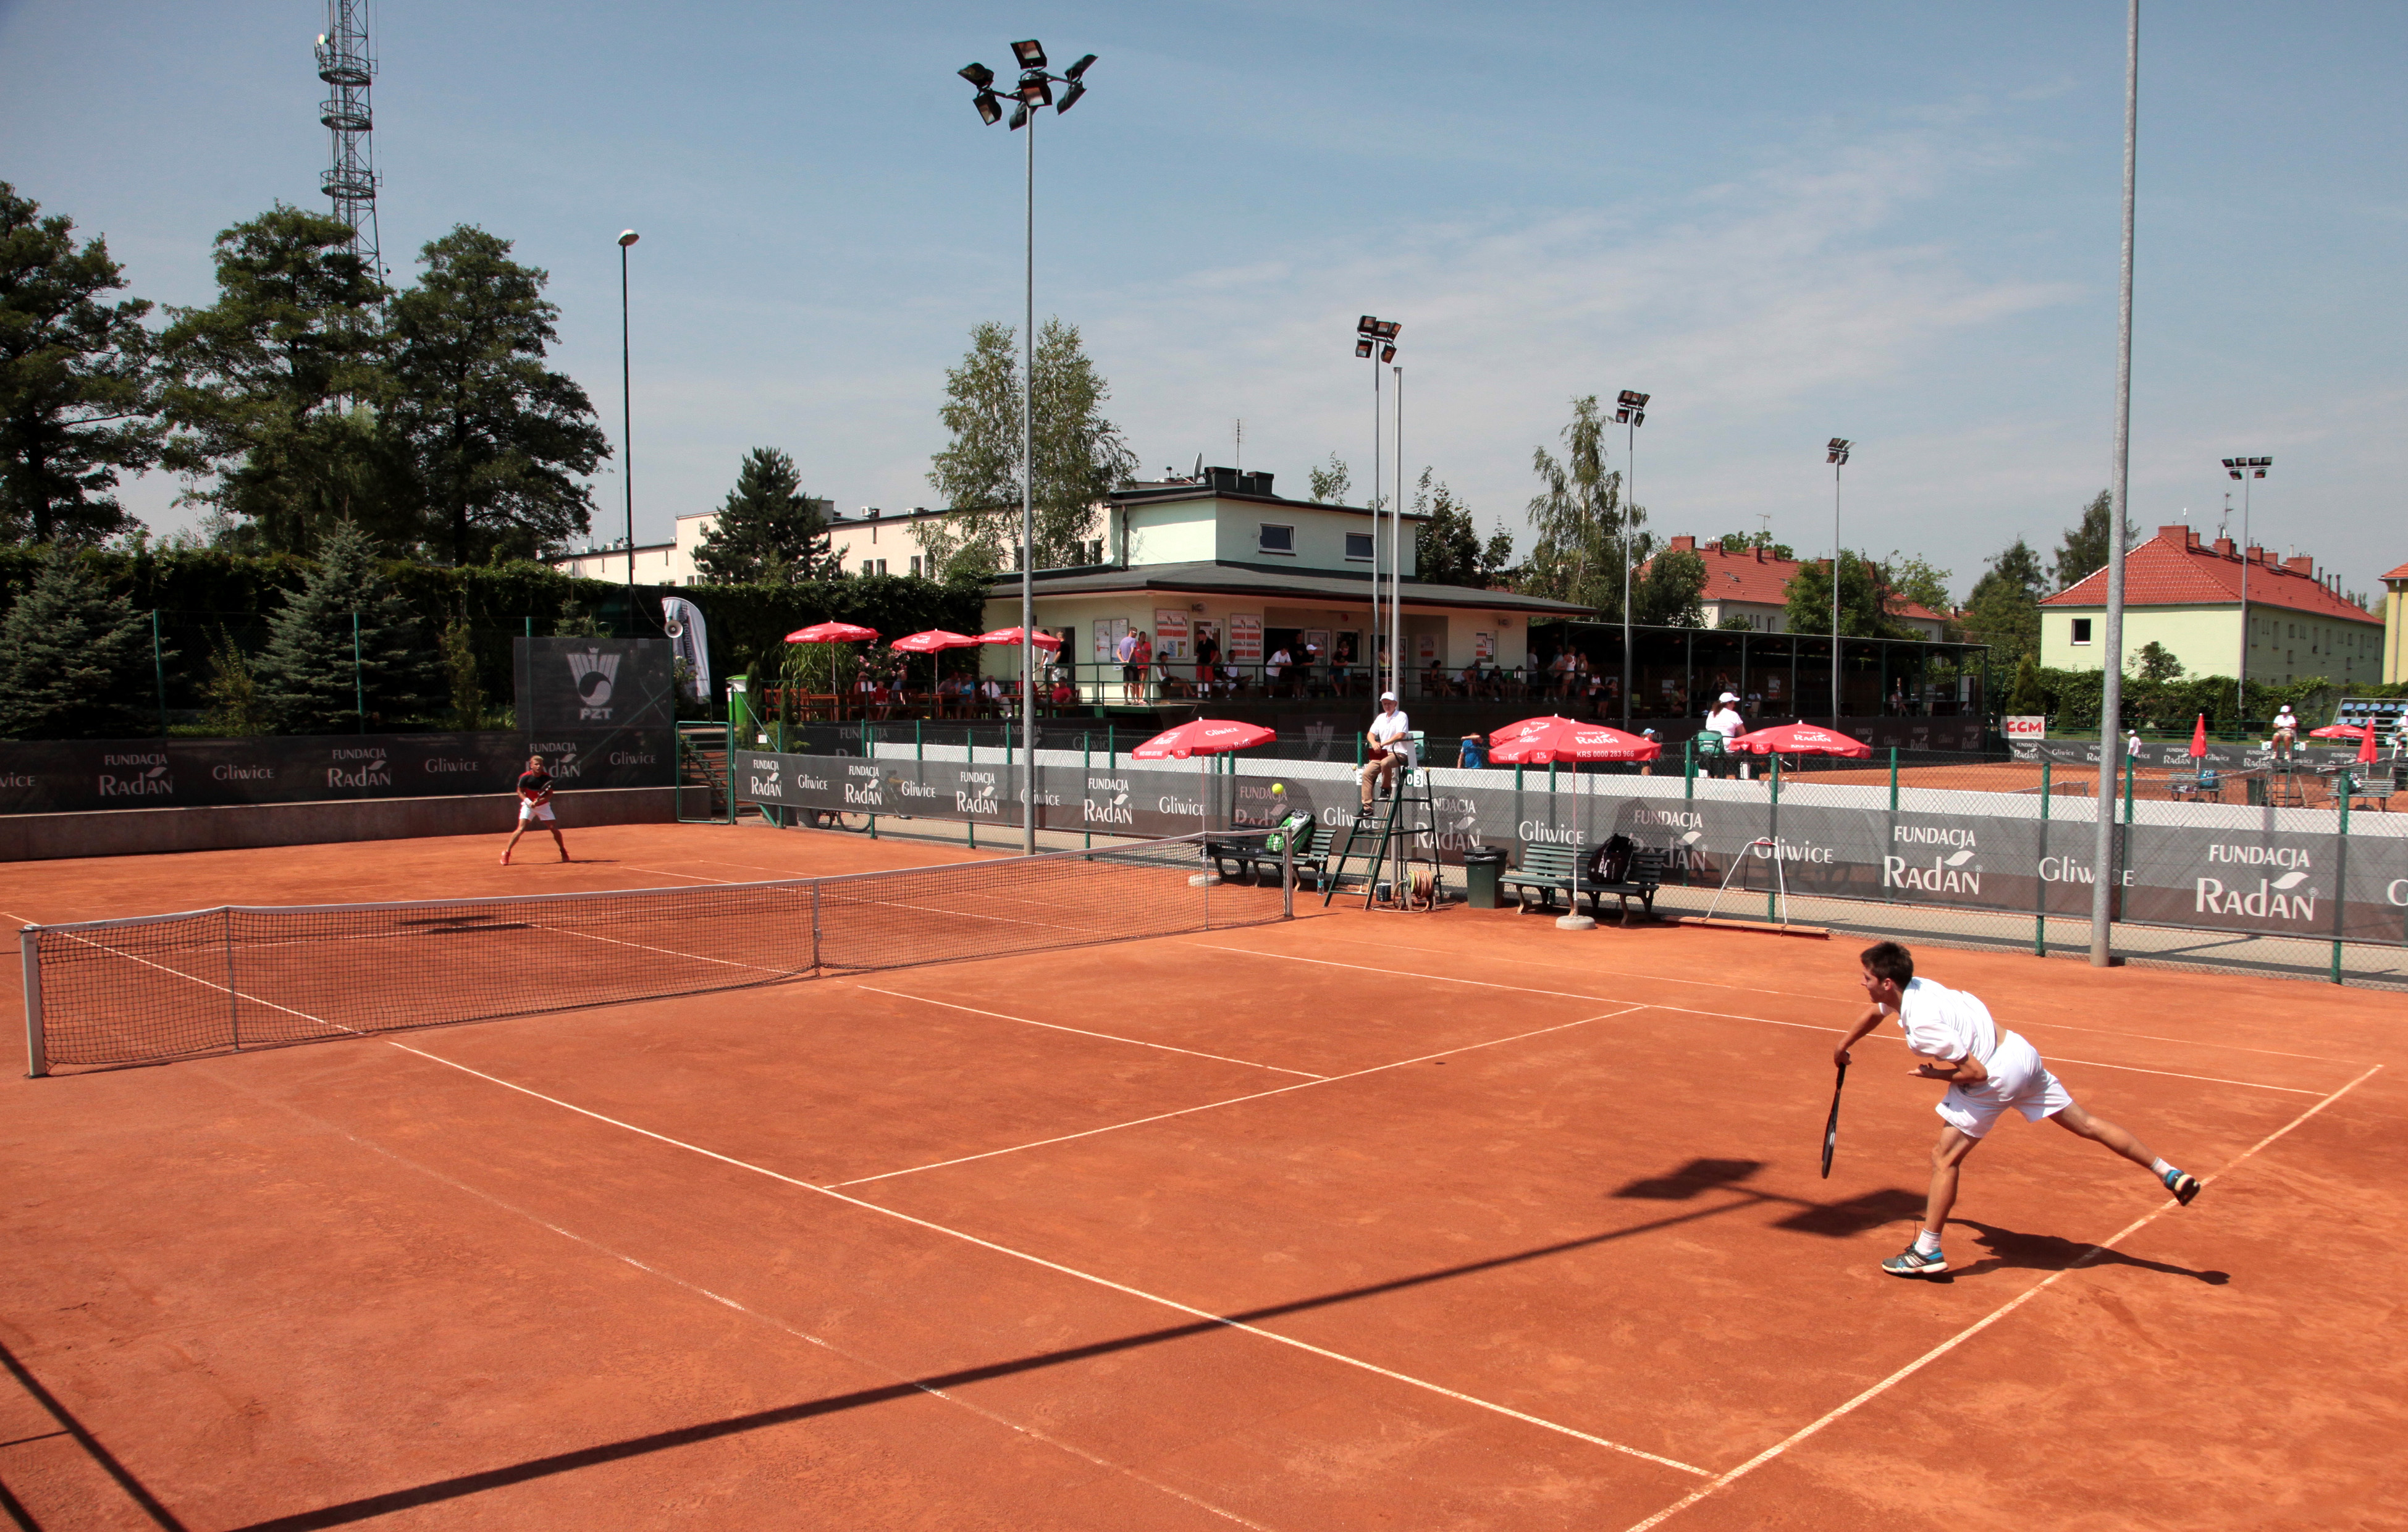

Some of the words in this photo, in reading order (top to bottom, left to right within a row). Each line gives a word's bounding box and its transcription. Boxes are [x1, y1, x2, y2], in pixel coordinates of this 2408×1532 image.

[579, 707, 613, 720] PZT
[1205, 727, 1240, 736] Gliwice
[2006, 721, 2042, 733] CCM
[332, 748, 387, 759] FUNDACJA
[529, 743, 577, 753] FUNDACJA
[104, 754, 167, 766] FUNDACJA
[753, 759, 780, 772] FUNDACJA
[849, 765, 880, 778] FUNDACJA
[960, 772, 995, 785] FUNDACJA
[1088, 778, 1129, 793] FUNDACJA
[1420, 796, 1476, 815] FUNDACJA
[1635, 810, 1703, 830] FUNDACJA
[1894, 825, 1976, 849] FUNDACJA
[2208, 844, 2310, 870] FUNDACJA
